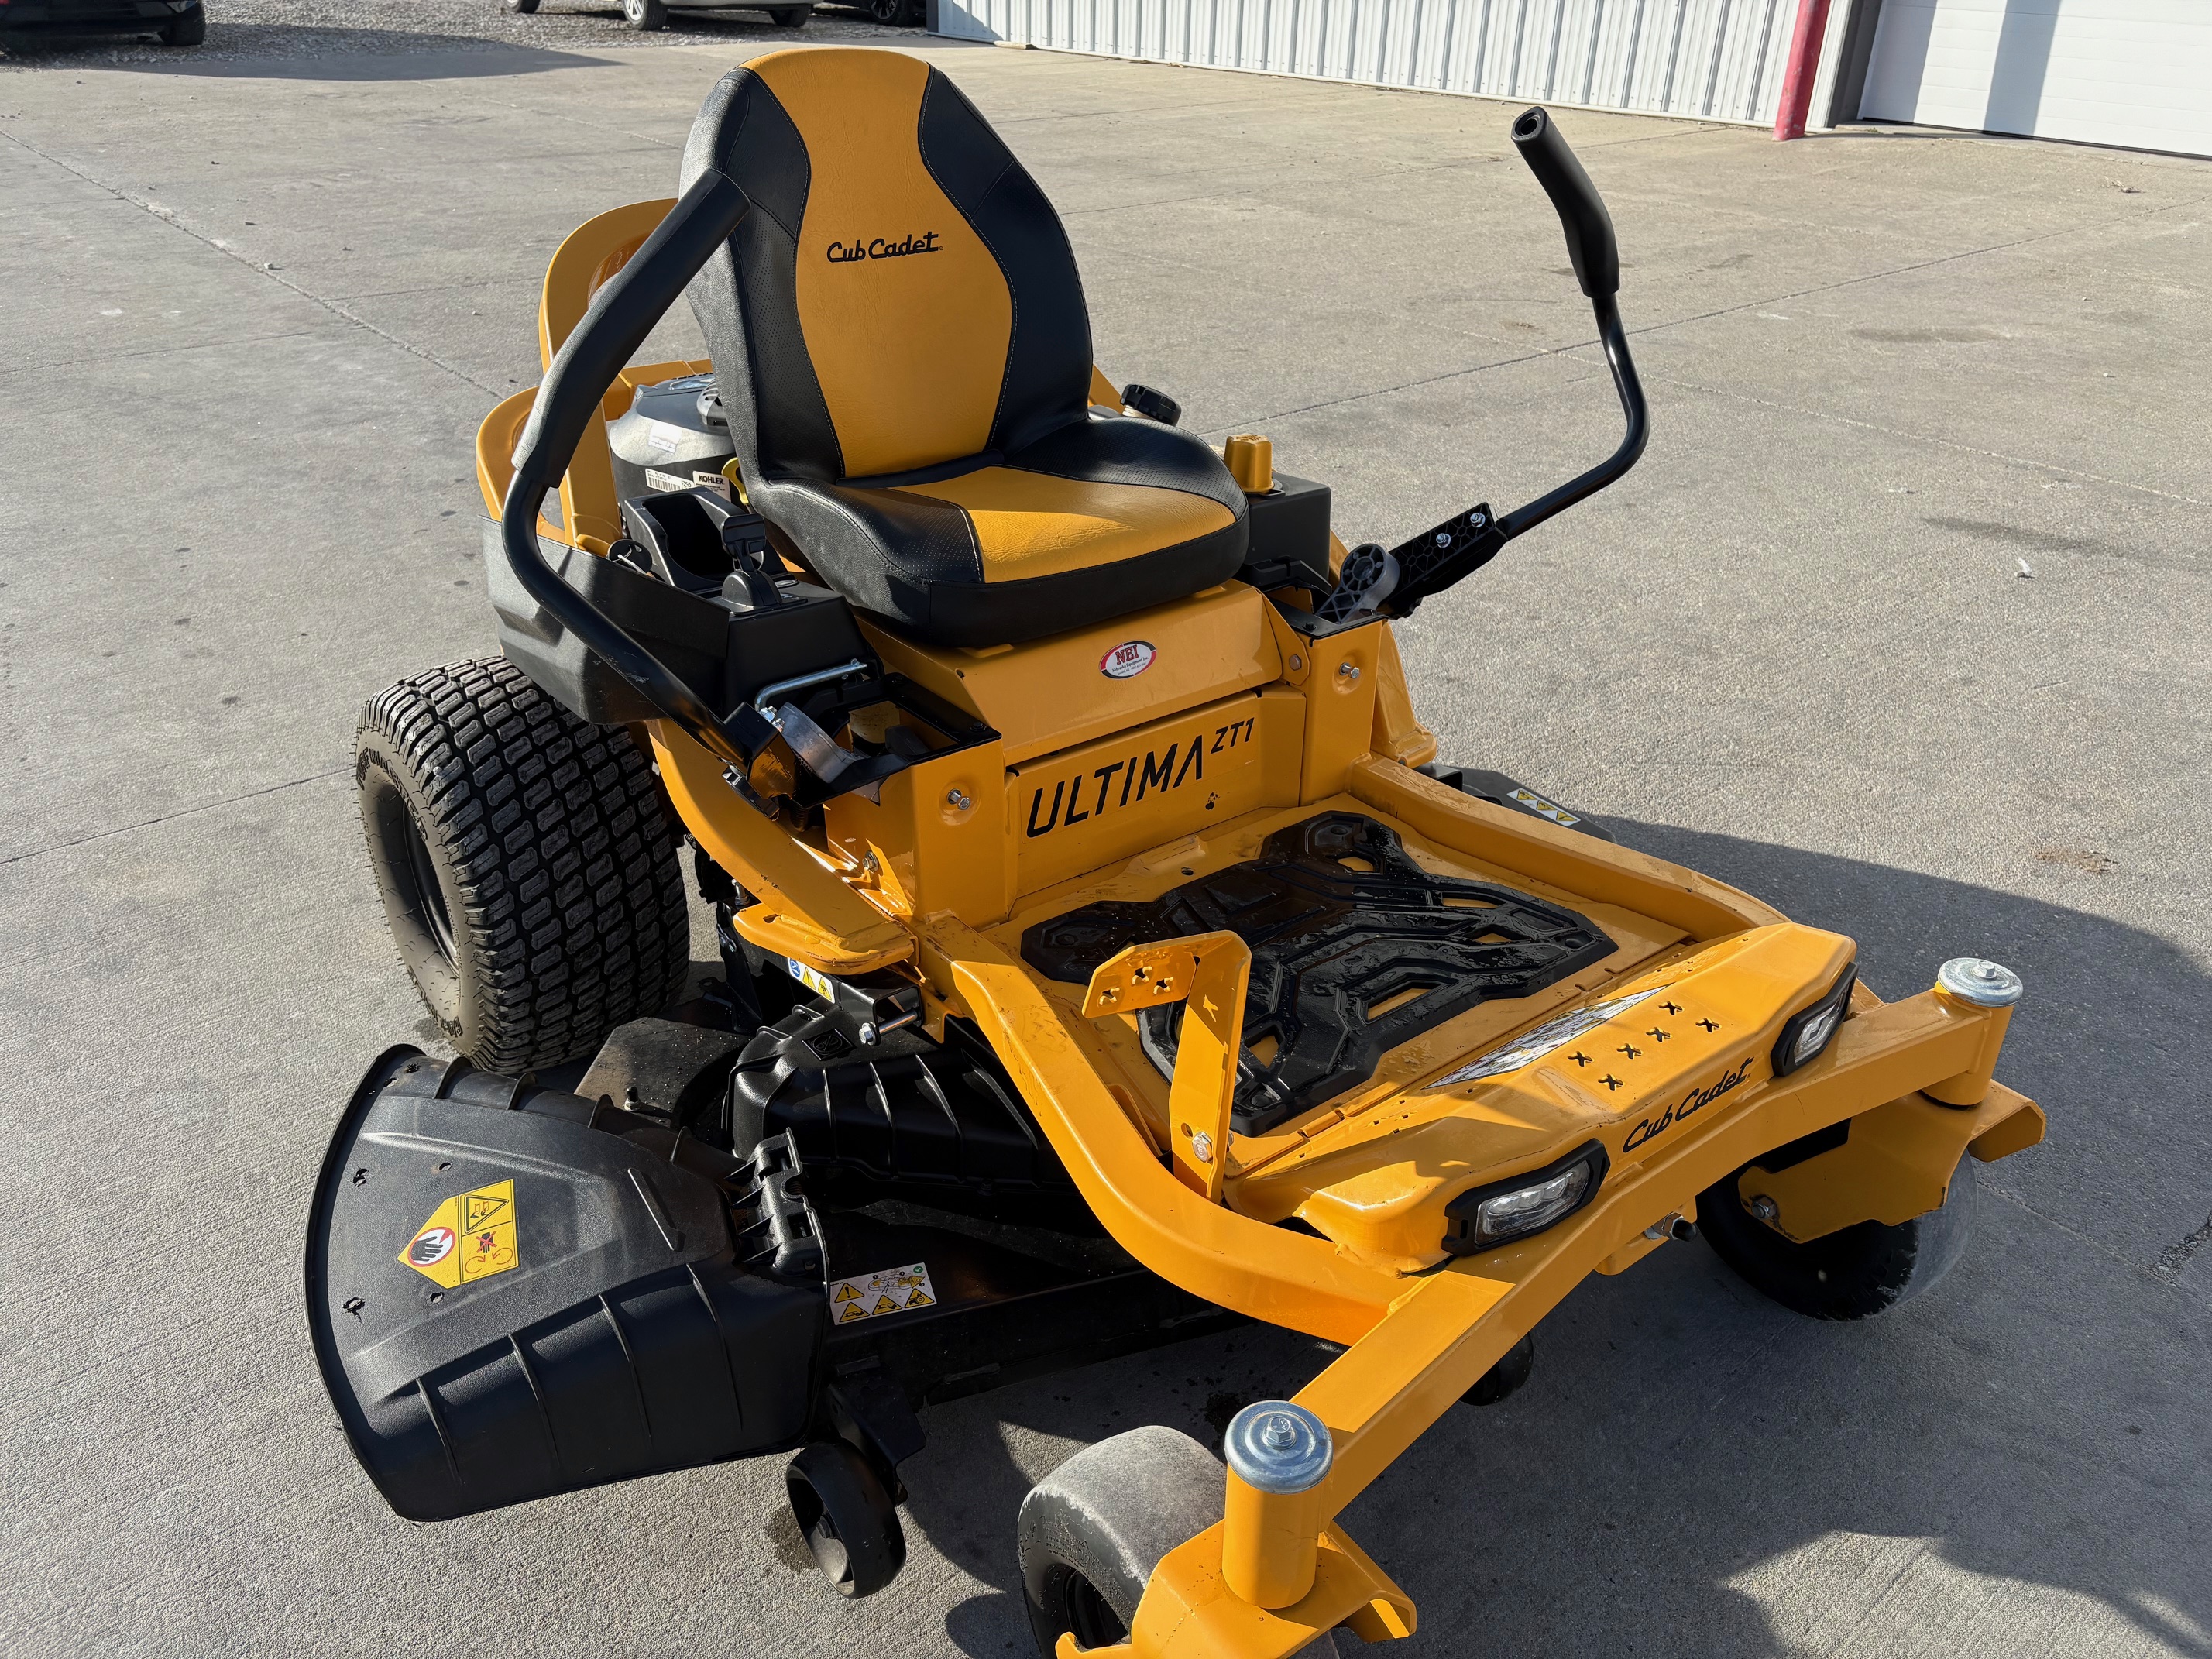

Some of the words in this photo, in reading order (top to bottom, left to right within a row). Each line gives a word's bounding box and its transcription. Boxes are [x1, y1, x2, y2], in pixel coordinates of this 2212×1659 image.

[826, 239, 866, 263] Cub
[868, 232, 939, 259] Cadet
[699, 474, 724, 484] KOHLER
[1115, 644, 1139, 665] NEI
[1210, 717, 1255, 754] ZT1
[1623, 1104, 1673, 1153] Cub
[1674, 1056, 1755, 1121] Cadet
